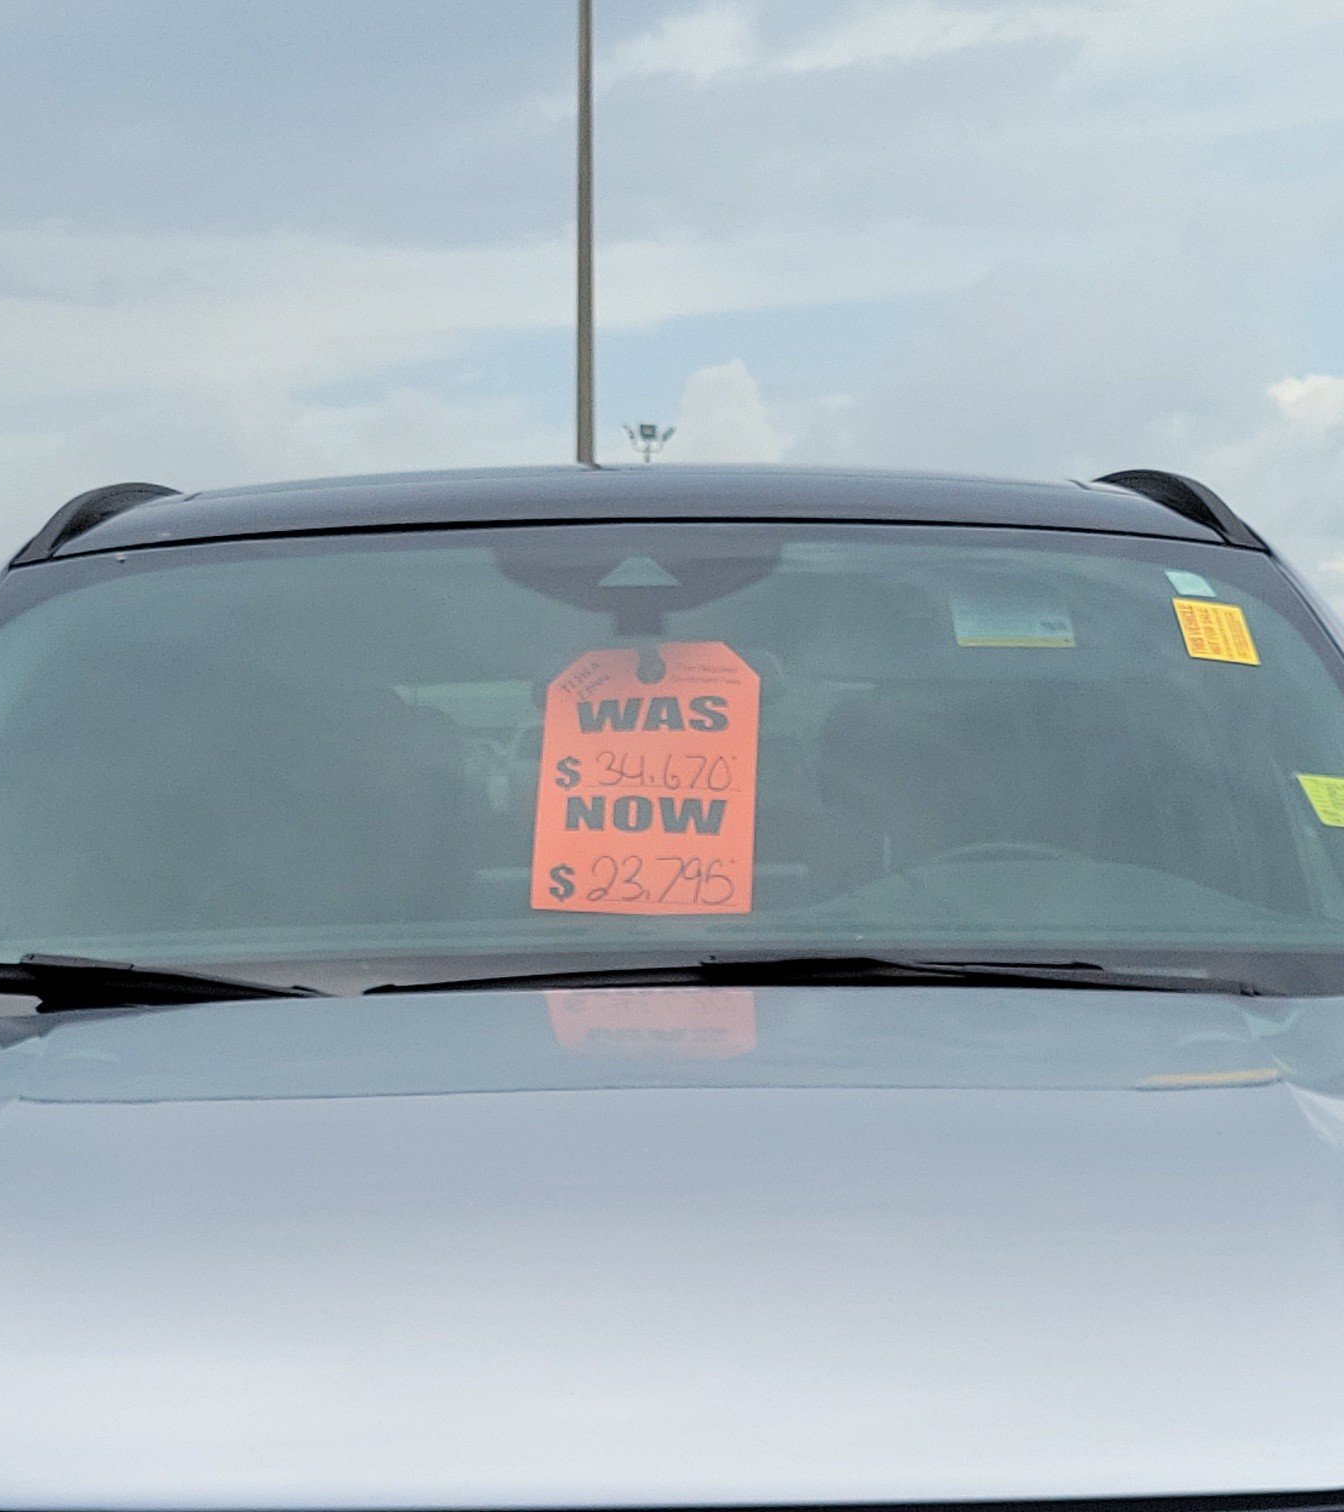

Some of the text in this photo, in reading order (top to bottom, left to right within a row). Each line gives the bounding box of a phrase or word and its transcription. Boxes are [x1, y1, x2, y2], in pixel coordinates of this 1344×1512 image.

[577, 695, 729, 734] WAS
[554, 755, 582, 790] $
[564, 795, 727, 836] NOW
[548, 862, 576, 902] $
